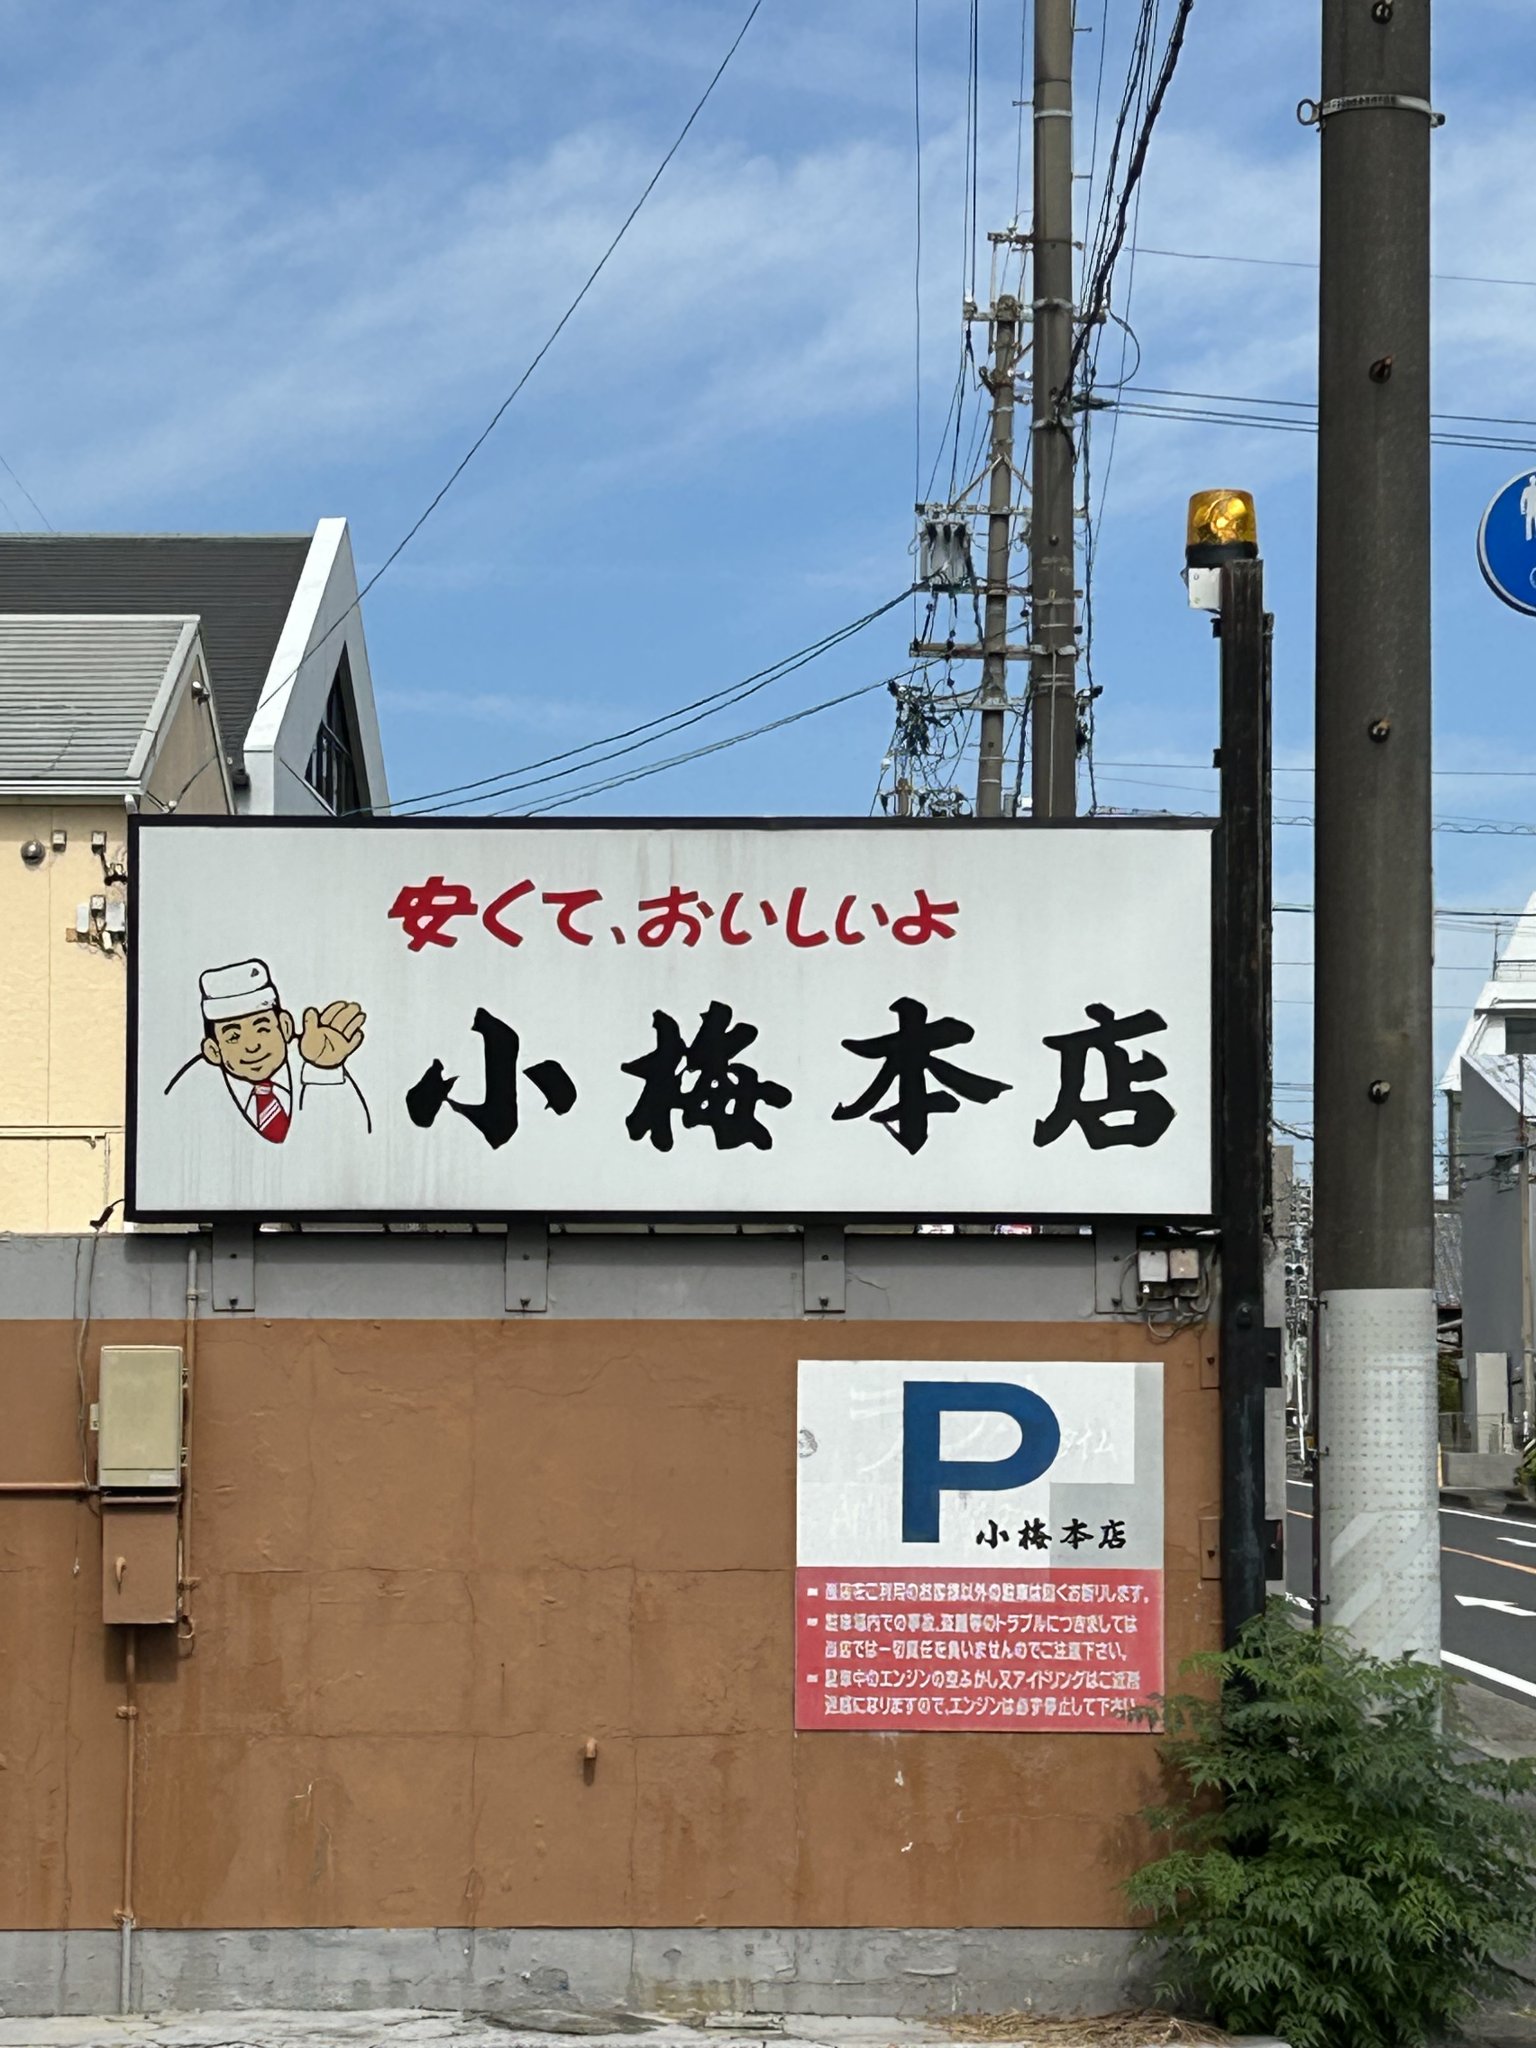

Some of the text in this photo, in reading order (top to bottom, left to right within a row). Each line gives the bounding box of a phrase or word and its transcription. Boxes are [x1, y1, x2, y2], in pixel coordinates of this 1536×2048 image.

[388, 876, 958, 952] 安くて、おいしいよ
[405, 997, 1176, 1156] 小梅本店
[903, 1380, 1060, 1543] P
[975, 1517, 1127, 1550] 小梅本店
